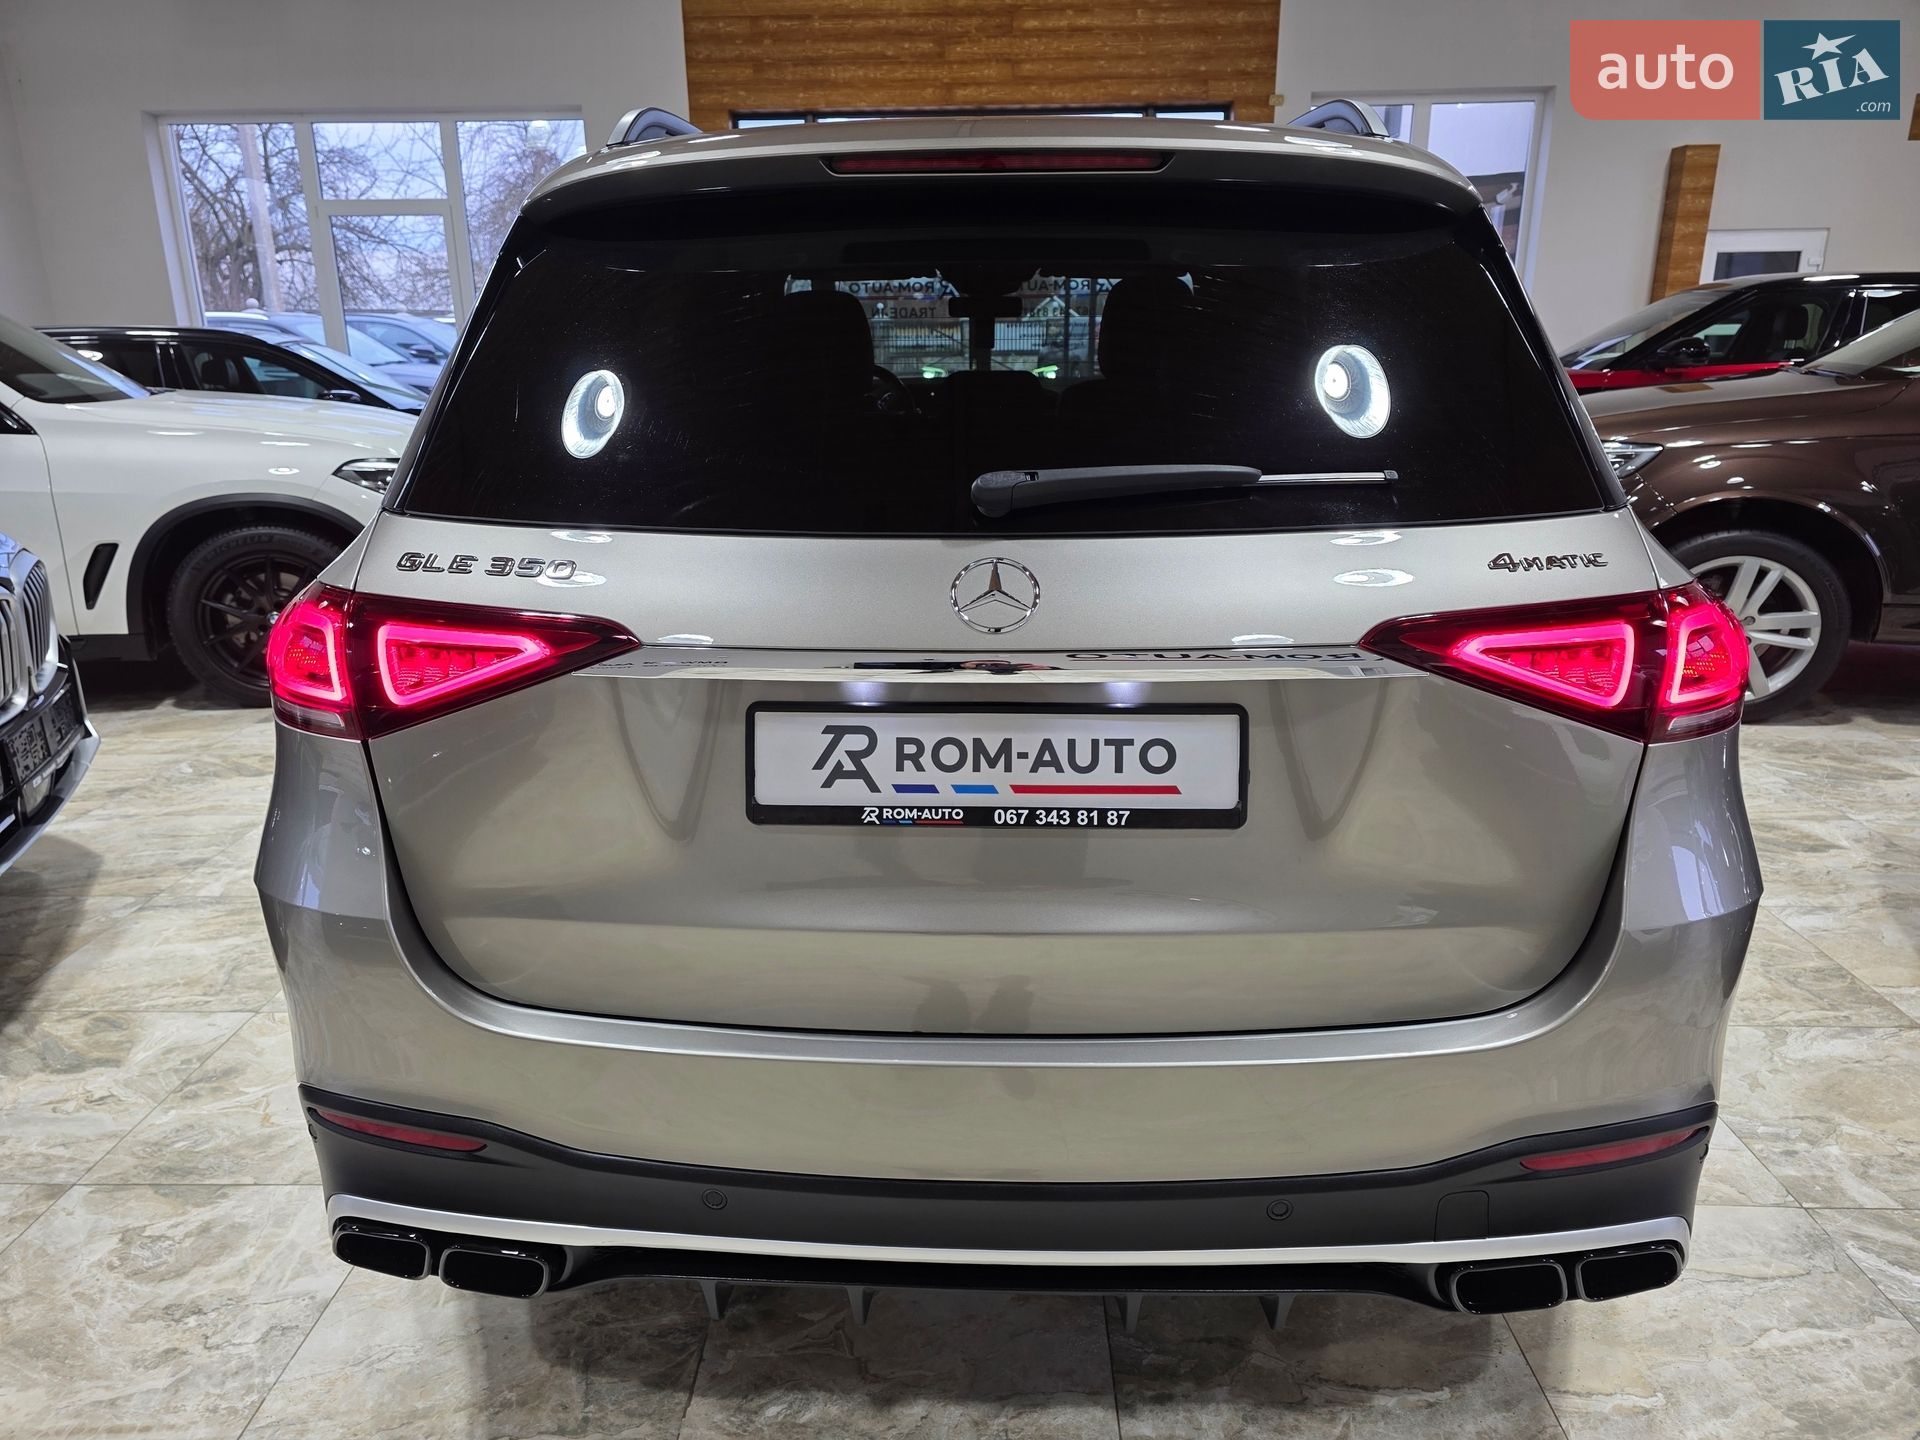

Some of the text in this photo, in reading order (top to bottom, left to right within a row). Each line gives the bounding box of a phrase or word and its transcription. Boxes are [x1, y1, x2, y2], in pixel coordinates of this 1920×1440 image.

[396, 552, 577, 580] GLE 350
[1487, 552, 1608, 573] 4MATIC
[895, 737, 1178, 775] ROM-AUTO
[882, 808, 964, 820] ROM-AUTO
[993, 809, 1028, 825] 067
[1035, 809, 1071, 825] 343
[1076, 810, 1099, 826] 81
[1106, 810, 1131, 826] 87
